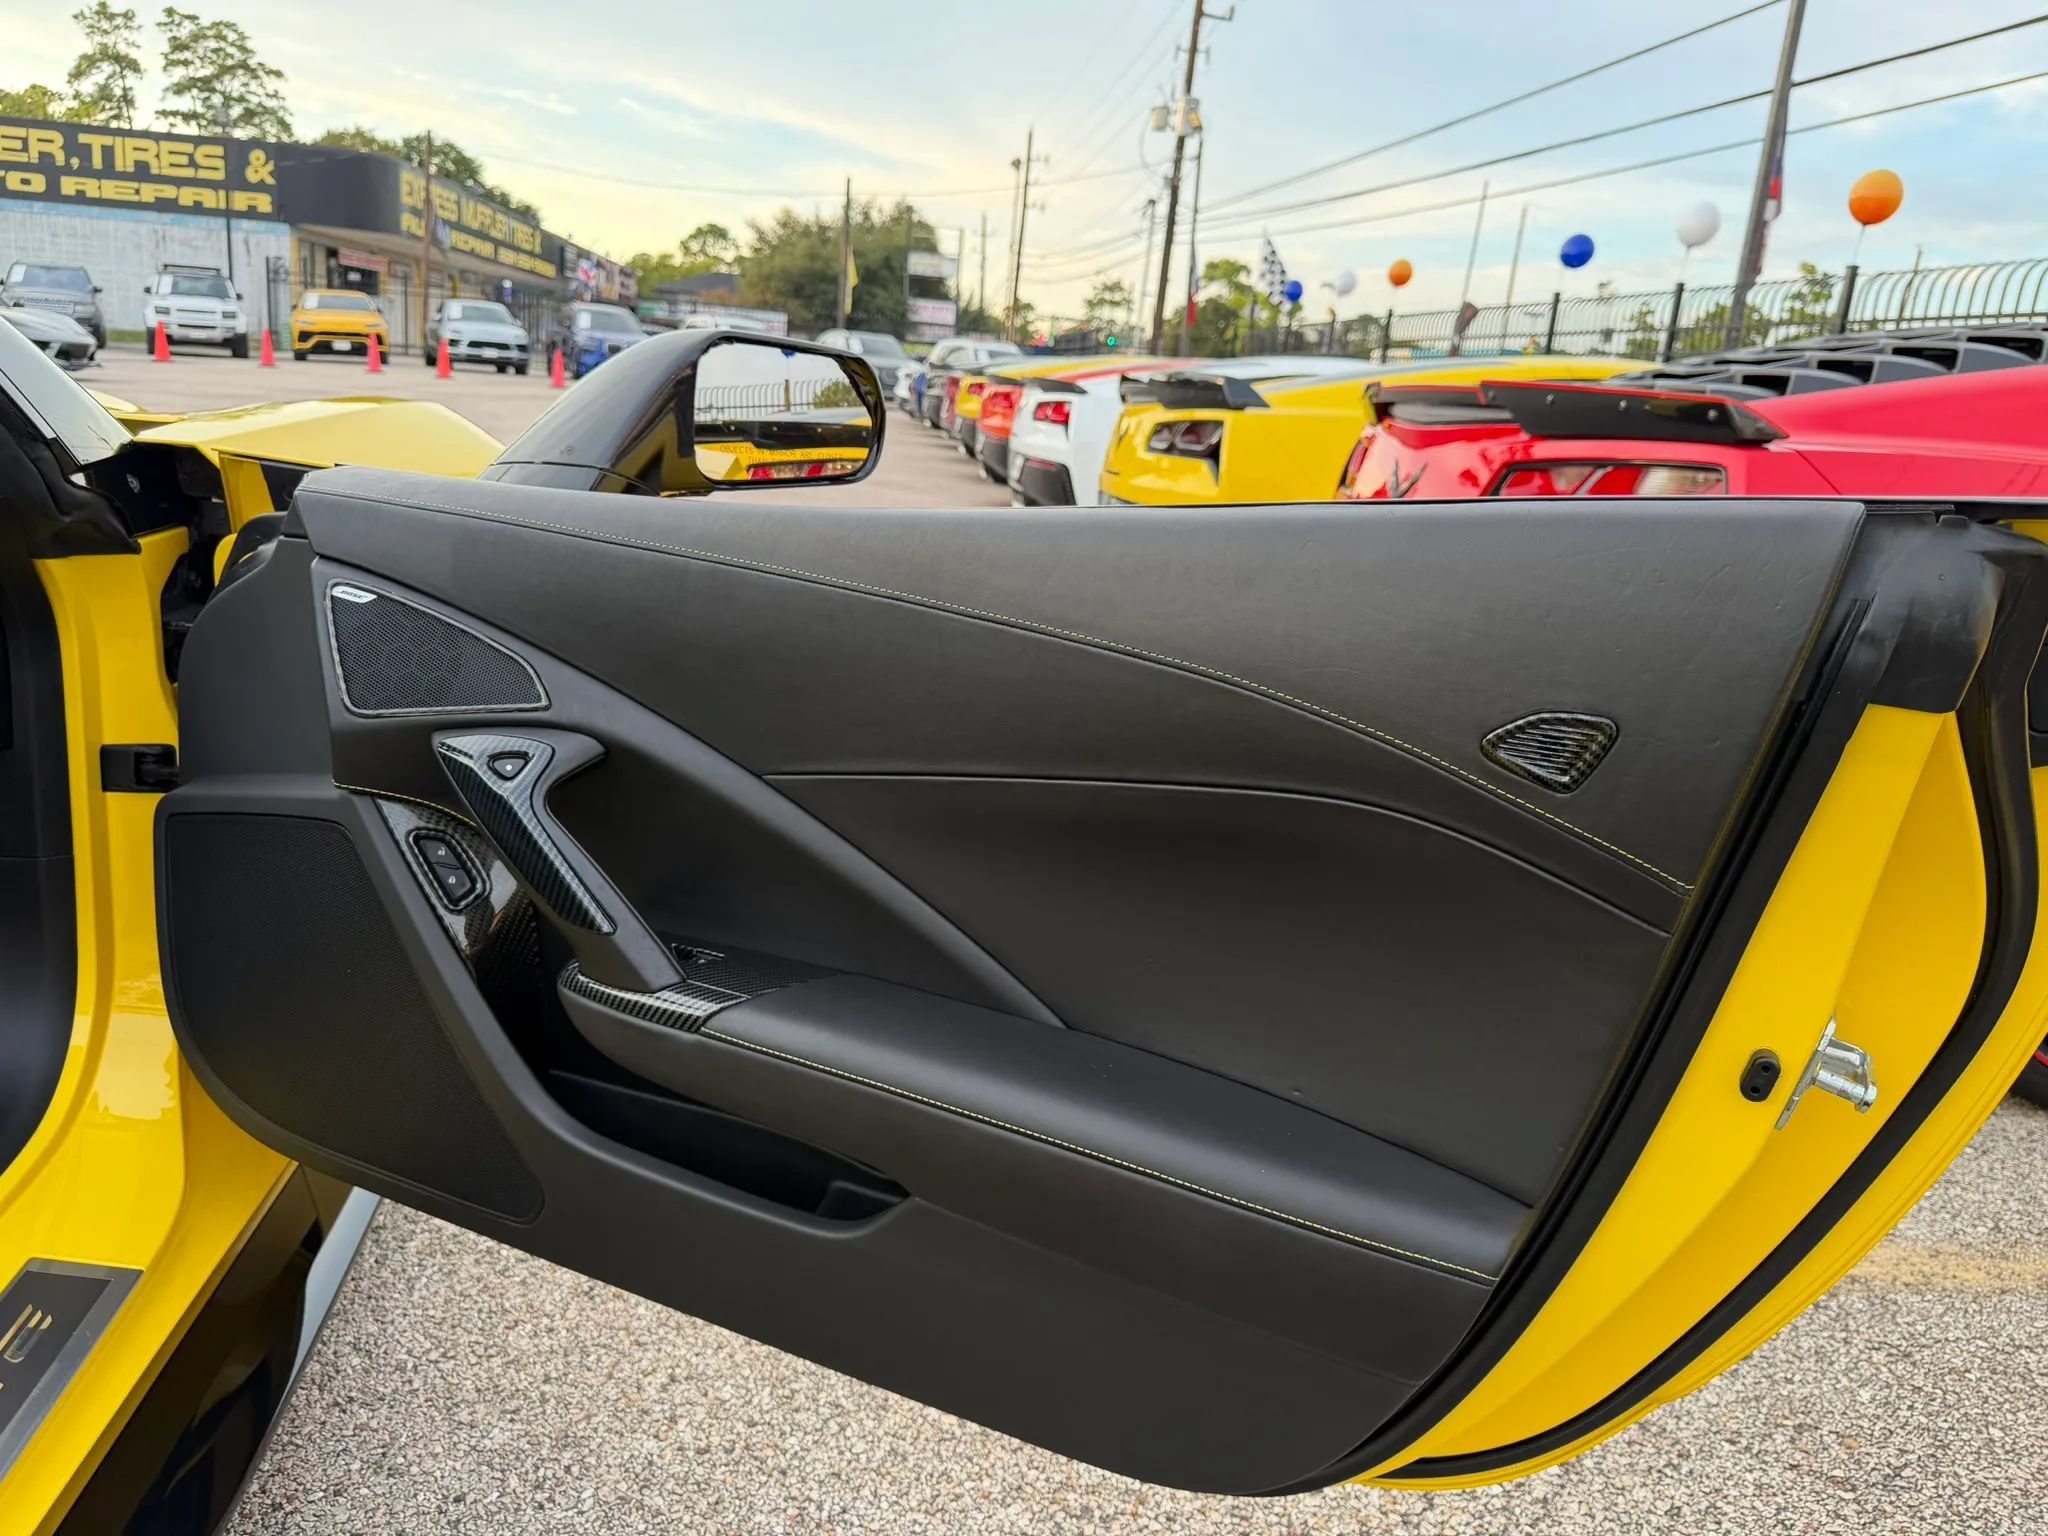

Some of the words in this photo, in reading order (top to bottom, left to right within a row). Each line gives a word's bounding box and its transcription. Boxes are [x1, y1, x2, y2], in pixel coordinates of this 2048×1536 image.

[245, 149, 277, 185] &
[60, 175, 273, 214] REPAIR
[719, 445, 754, 455] OBJECTS
